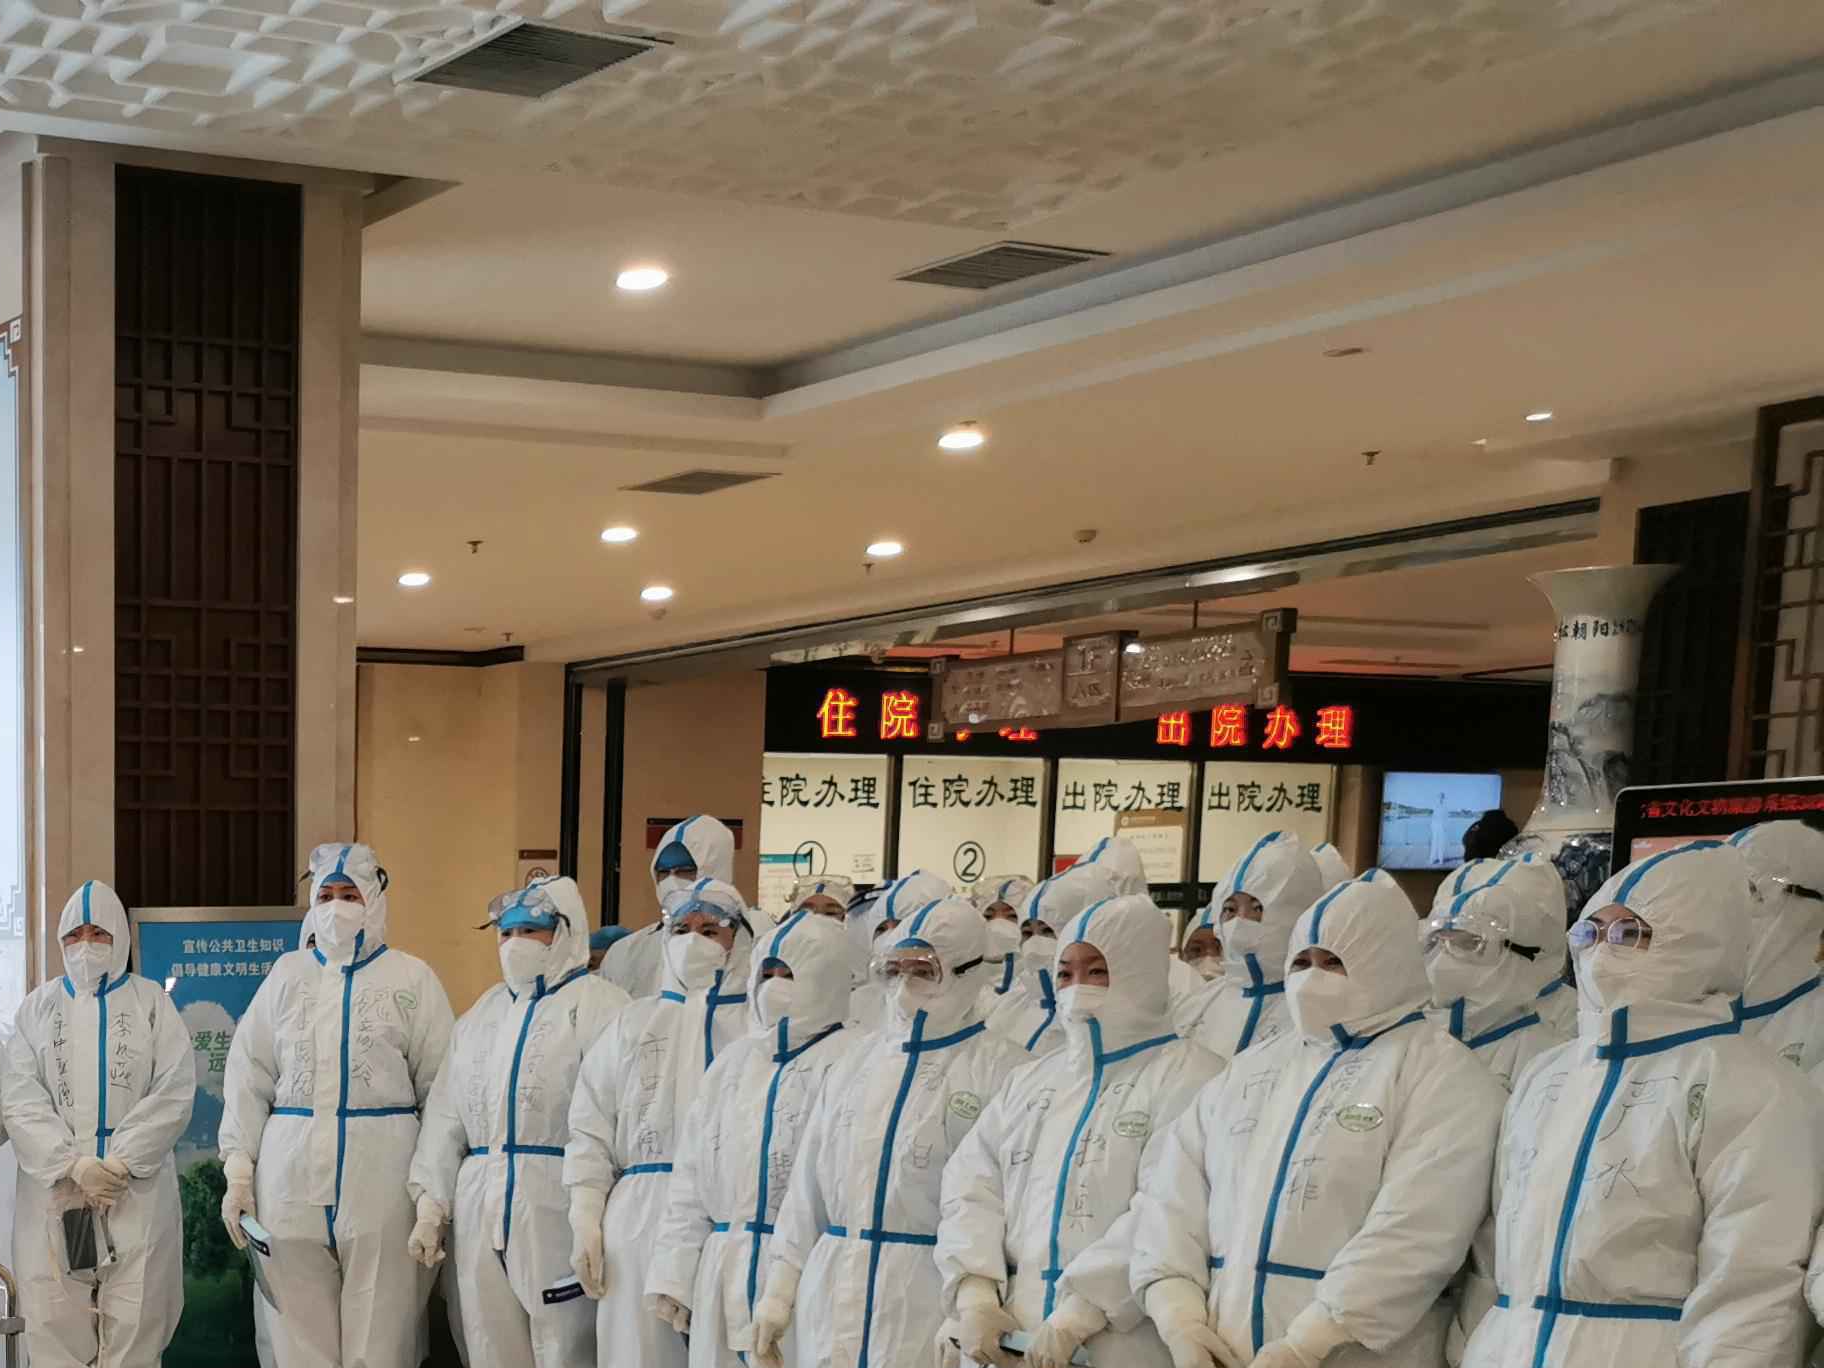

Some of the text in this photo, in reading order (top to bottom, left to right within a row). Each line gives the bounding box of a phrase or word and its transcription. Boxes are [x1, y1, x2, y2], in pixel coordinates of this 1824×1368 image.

[1156, 702, 1353, 749] 出院办理
[908, 773, 1038, 809] 住院办理
[1061, 778, 1185, 813] 出院办理
[1207, 780, 1323, 813] 出院办理
[182, 938, 285, 953] 宣传公共卫生知识
